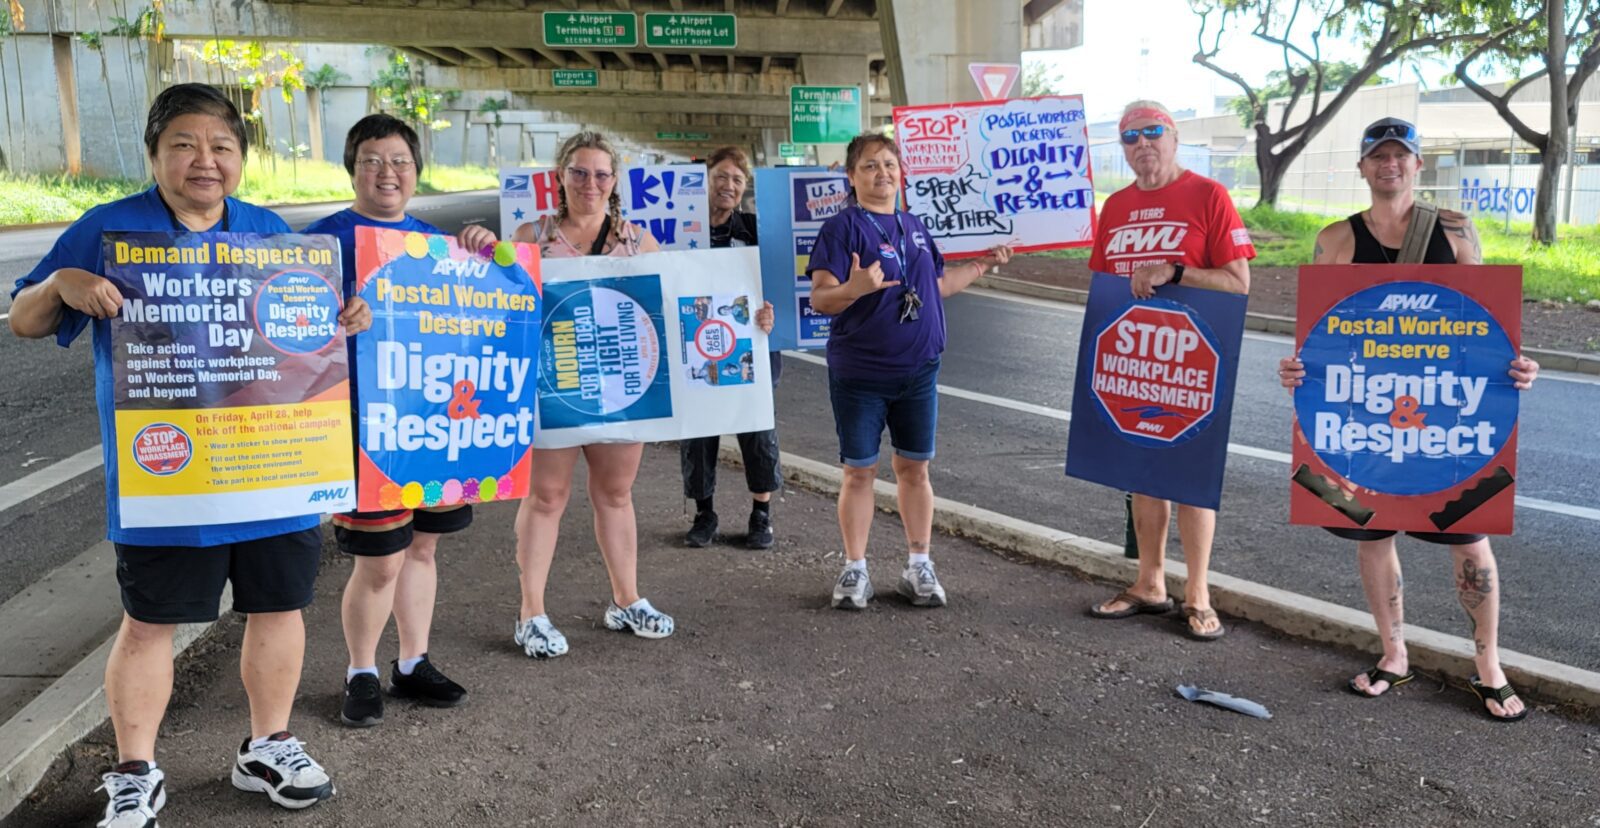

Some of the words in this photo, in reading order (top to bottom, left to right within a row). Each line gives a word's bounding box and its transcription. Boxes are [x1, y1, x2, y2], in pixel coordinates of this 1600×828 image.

[555, 25, 601, 35] Terminals
[580, 15, 613, 25] Airport
[680, 16, 713, 26] Airport
[664, 26, 682, 36] Cell
[684, 27, 712, 36] Phone
[714, 28, 729, 37] Lot
[555, 72, 584, 80] Airport
[798, 89, 840, 100] Terminal
[794, 104, 805, 113] All
[809, 105, 832, 113] Other
[794, 114, 825, 122] Airlines
[904, 114, 967, 137] STOP!
[986, 112, 1037, 131] POSTAL
[1037, 109, 1085, 124] WORKERS
[990, 143, 1084, 170] DIGNITY
[915, 177, 981, 197] SPEAK
[1024, 165, 1043, 193] &
[811, 184, 841, 198] U.S.
[932, 195, 961, 214] UP
[1140, 207, 1166, 221] YEARS
[1105, 226, 1188, 256] APWU
[115, 242, 211, 264] Demand
[215, 242, 303, 270] Respect
[308, 248, 332, 265] on
[432, 258, 491, 279] APWU
[142, 272, 252, 297] Workers
[268, 285, 295, 294] Postal
[295, 285, 329, 293] Workers
[376, 277, 450, 306] Postal
[453, 285, 536, 312] Workers
[283, 294, 316, 302] Deserve
[1378, 294, 1438, 310] APWU
[122, 298, 246, 323] Memorial
[269, 303, 330, 323] Dignity
[265, 322, 336, 341] Respect
[419, 311, 506, 338] Deserve
[573, 306, 594, 343] DEAD
[617, 301, 637, 342] LIVING
[1327, 316, 1394, 335] Postal
[1398, 316, 1489, 336] Workers
[208, 323, 254, 352] Day
[705, 328, 714, 353] SAFE
[712, 327, 721, 353] JOBS
[1115, 320, 1199, 364] STOP
[127, 343, 154, 355] Take
[157, 343, 196, 354] action
[545, 339, 553, 372] AFL-CIO
[552, 320, 581, 390] MOURN
[577, 345, 597, 371] THE
[597, 325, 622, 376] FIGHT
[621, 345, 639, 369] THE
[1363, 339, 1450, 359] Deserve
[127, 357, 172, 370] against
[174, 356, 205, 369] toxic
[208, 356, 276, 369] workplaces
[377, 341, 531, 404] Dignity
[1102, 353, 1209, 389] WORKPLACE
[127, 373, 142, 384] on
[145, 372, 196, 384] Workers
[198, 369, 254, 383] Memorial
[257, 368, 282, 382] Day,
[624, 371, 641, 396] FOR
[128, 386, 151, 399] and
[153, 385, 197, 400] beyond
[580, 373, 599, 400] FOR
[1095, 373, 1212, 412] HARASSMENT
[1325, 364, 1488, 416] Dignity
[447, 379, 483, 421] &
[196, 413, 209, 424] On
[212, 412, 247, 425] Friday,
[250, 410, 273, 422] April
[275, 409, 291, 421] 28,
[293, 408, 313, 419] help
[1388, 395, 1427, 430] &
[196, 426, 219, 437] kick
[222, 424, 236, 435] off
[240, 423, 255, 434] the
[258, 421, 297, 433] national
[300, 418, 341, 431] campaign
[367, 402, 533, 462] Respect
[1136, 421, 1165, 434] APWU
[1314, 411, 1496, 463] Respect
[140, 442, 185, 454] WORKPLACE
[143, 430, 178, 446] STOP
[209, 442, 228, 450] Wear
[237, 440, 261, 448] sticker
[289, 437, 303, 445] your
[305, 434, 328, 443] support
[139, 450, 189, 462] HARASSMENT
[251, 452, 270, 460] union
[271, 451, 292, 459] survey
[211, 465, 223, 473] the
[225, 463, 261, 472] workplace
[262, 459, 303, 468] environment
[212, 478, 229, 486] Take
[231, 477, 245, 486] part
[261, 474, 278, 482] local
[280, 472, 298, 480] union
[299, 470, 319, 478] action
[308, 486, 349, 503] APWU
